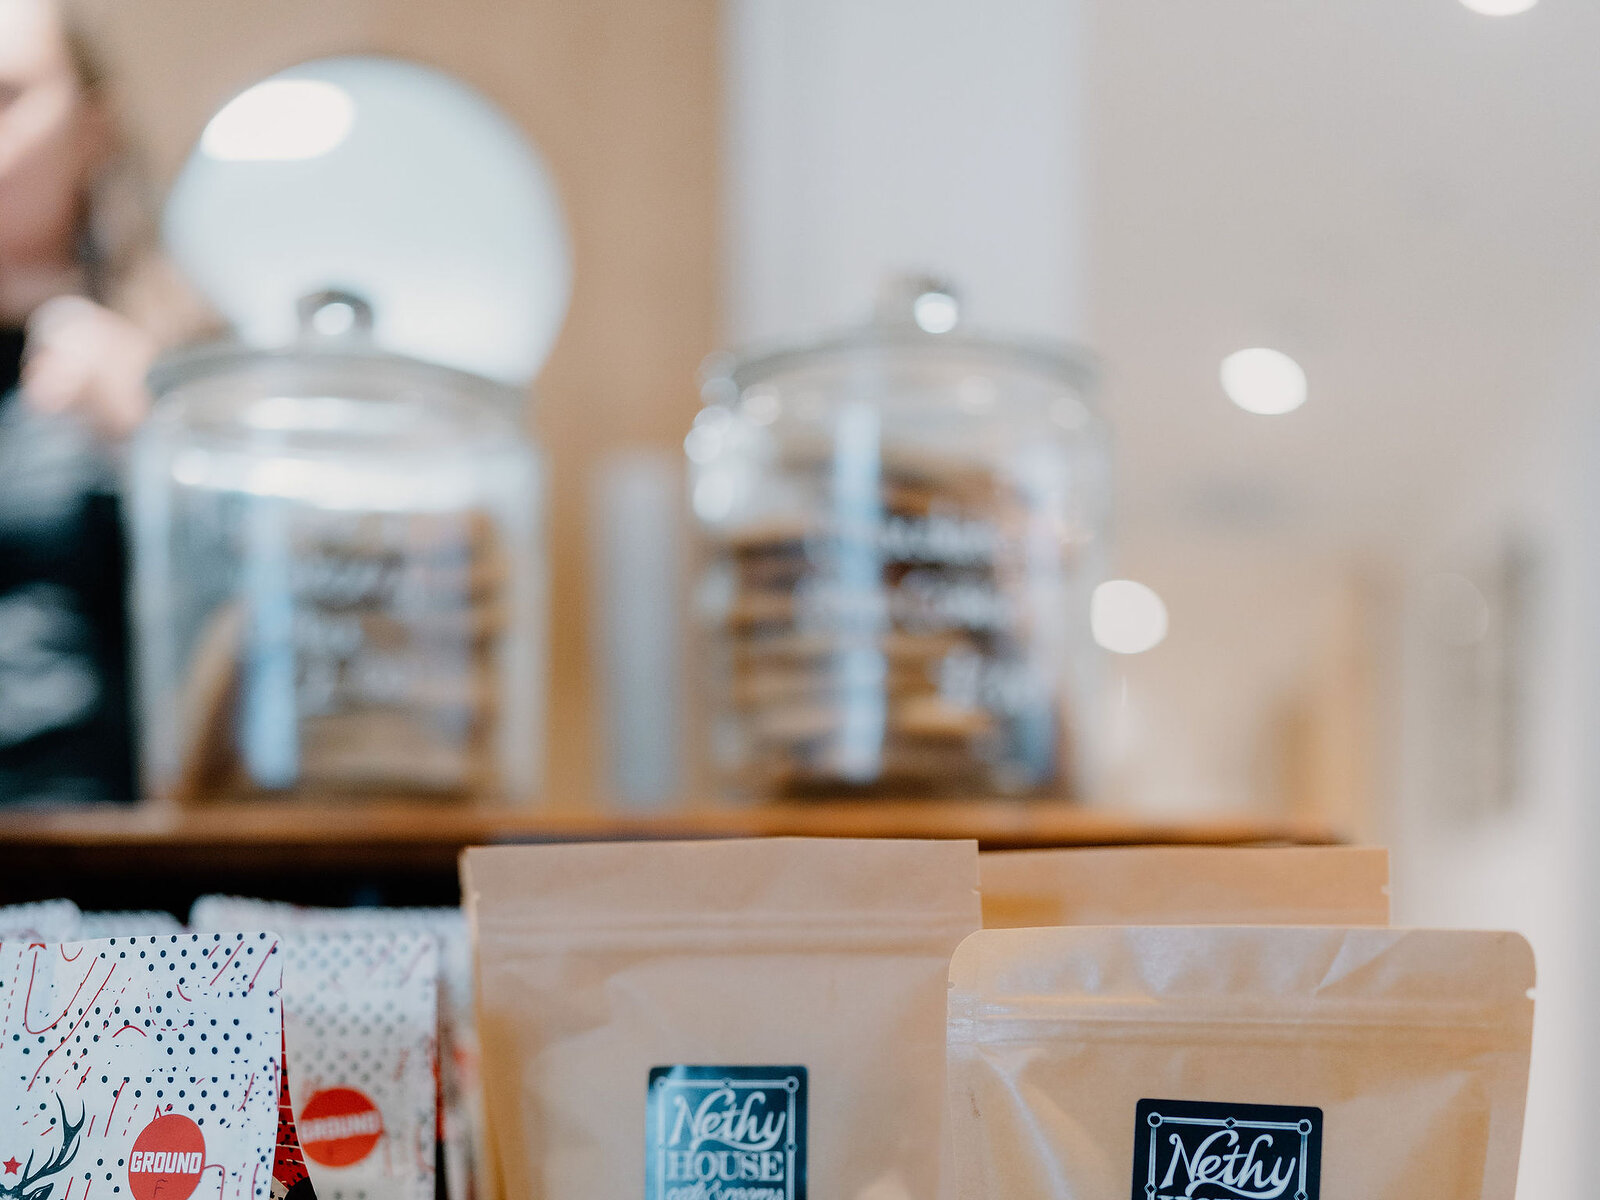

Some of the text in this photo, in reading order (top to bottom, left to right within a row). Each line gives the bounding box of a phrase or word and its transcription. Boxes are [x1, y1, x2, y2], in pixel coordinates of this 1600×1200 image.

[669, 1089, 786, 1151] Nethy
[130, 1151, 203, 1174] GROUND
[666, 1150, 784, 1181] HOUSE
[1159, 1129, 1296, 1199] Nethy
